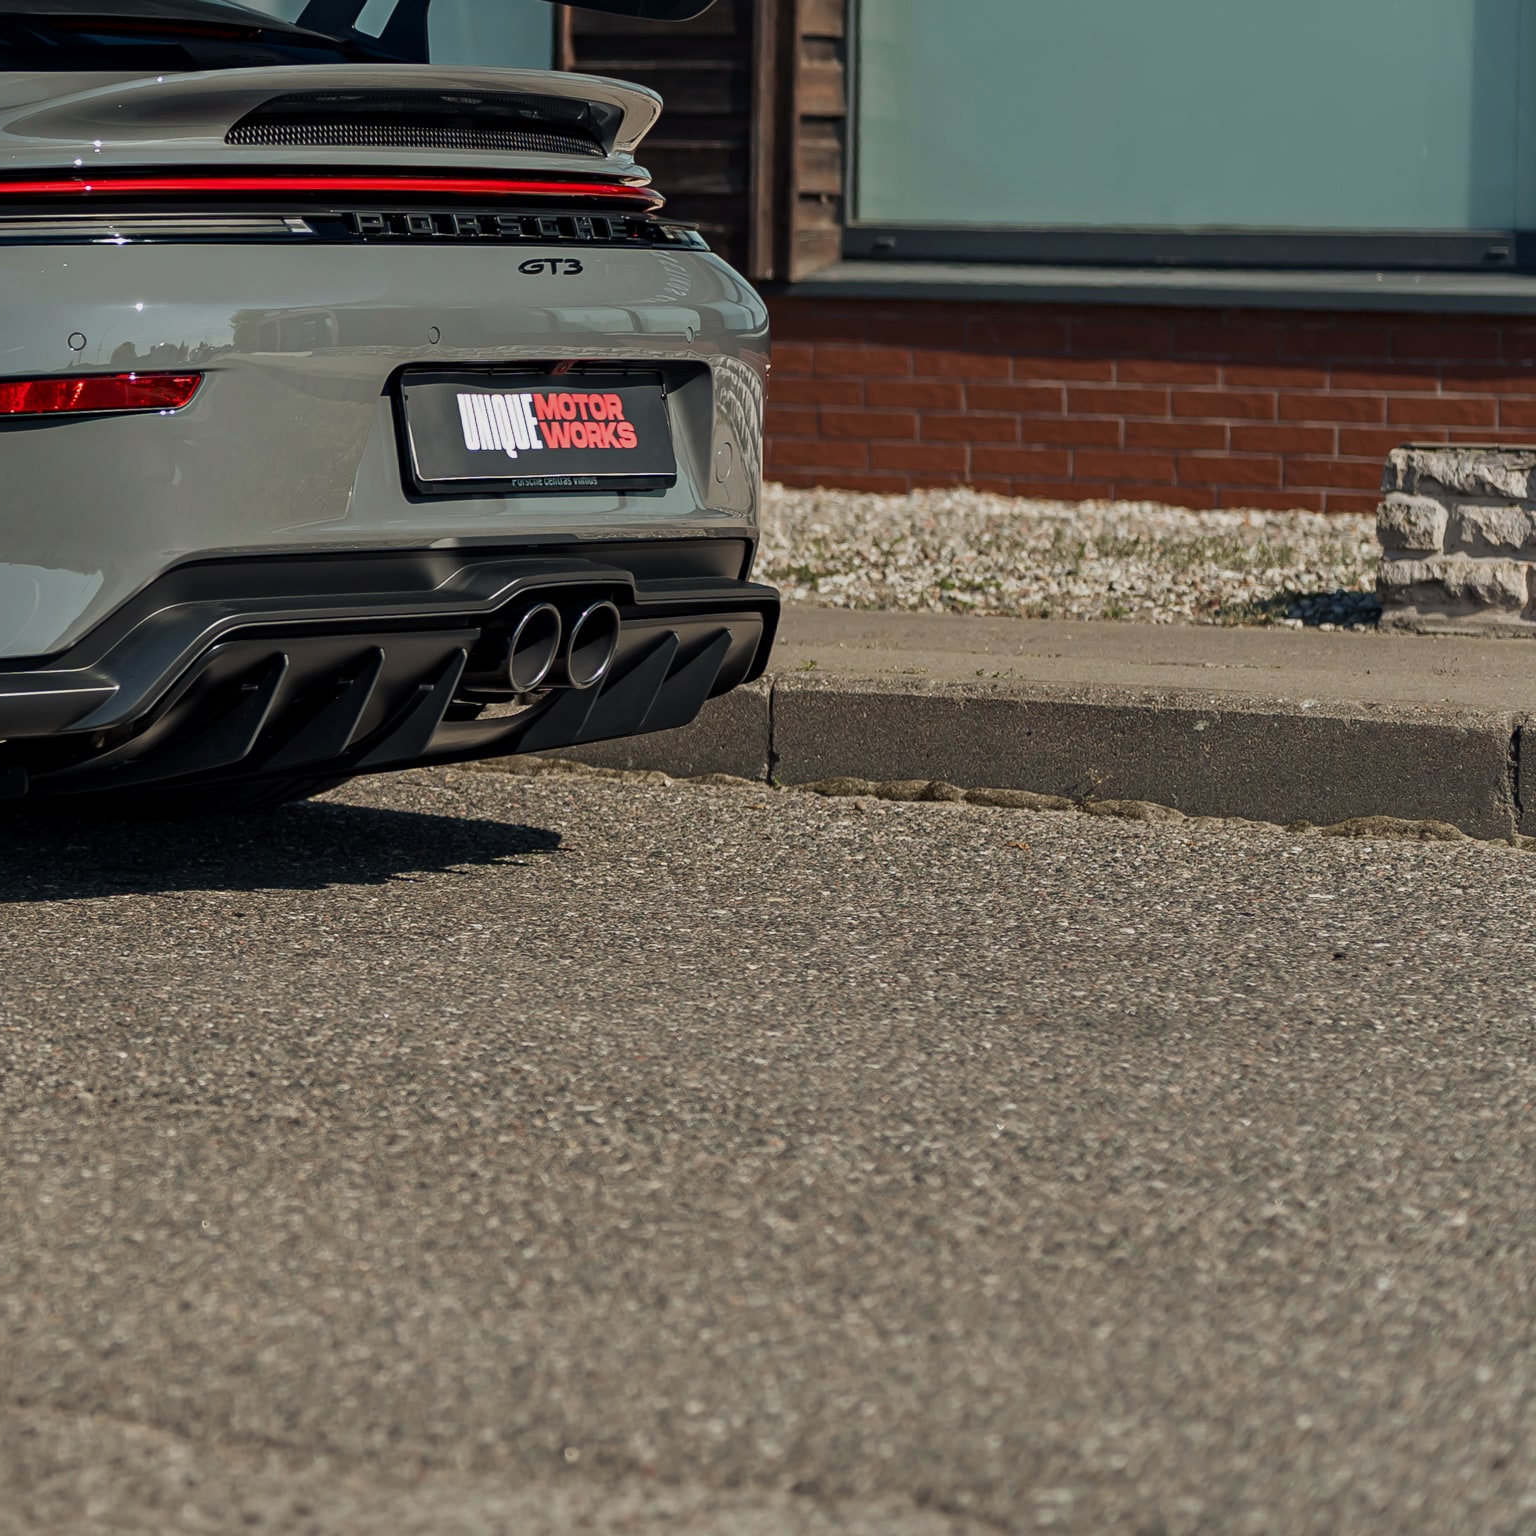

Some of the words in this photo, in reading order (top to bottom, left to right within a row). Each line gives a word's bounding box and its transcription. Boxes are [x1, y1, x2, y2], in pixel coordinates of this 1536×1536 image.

[354, 211, 629, 240] PORSCHE
[518, 258, 584, 276] GT3
[533, 392, 626, 421] MOTOR
[456, 392, 544, 459] UNIQUE
[539, 421, 638, 449] WORKS
